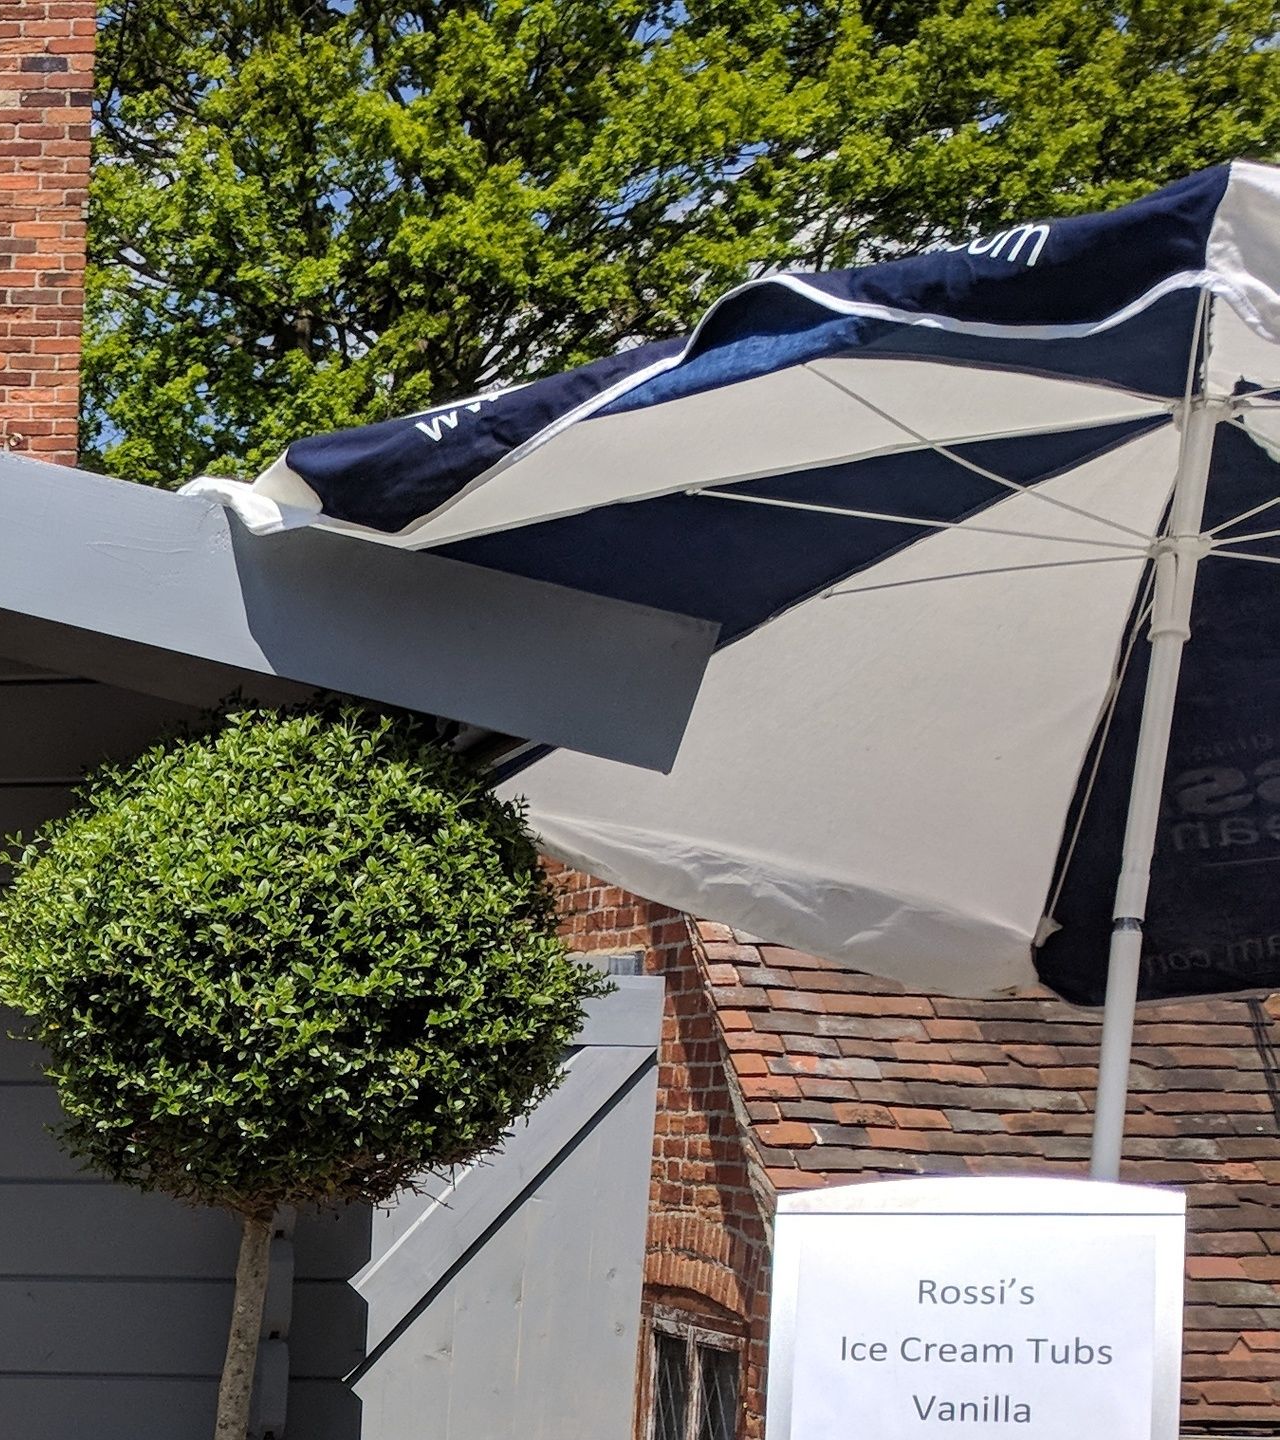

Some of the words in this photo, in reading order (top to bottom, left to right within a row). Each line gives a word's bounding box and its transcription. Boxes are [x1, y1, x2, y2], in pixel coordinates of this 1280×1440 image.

[841, 1336, 888, 1362] Ice
[900, 1336, 1014, 1364] Cream
[1026, 1337, 1113, 1365] Tubs
[912, 1394, 1031, 1424] Vanilla
